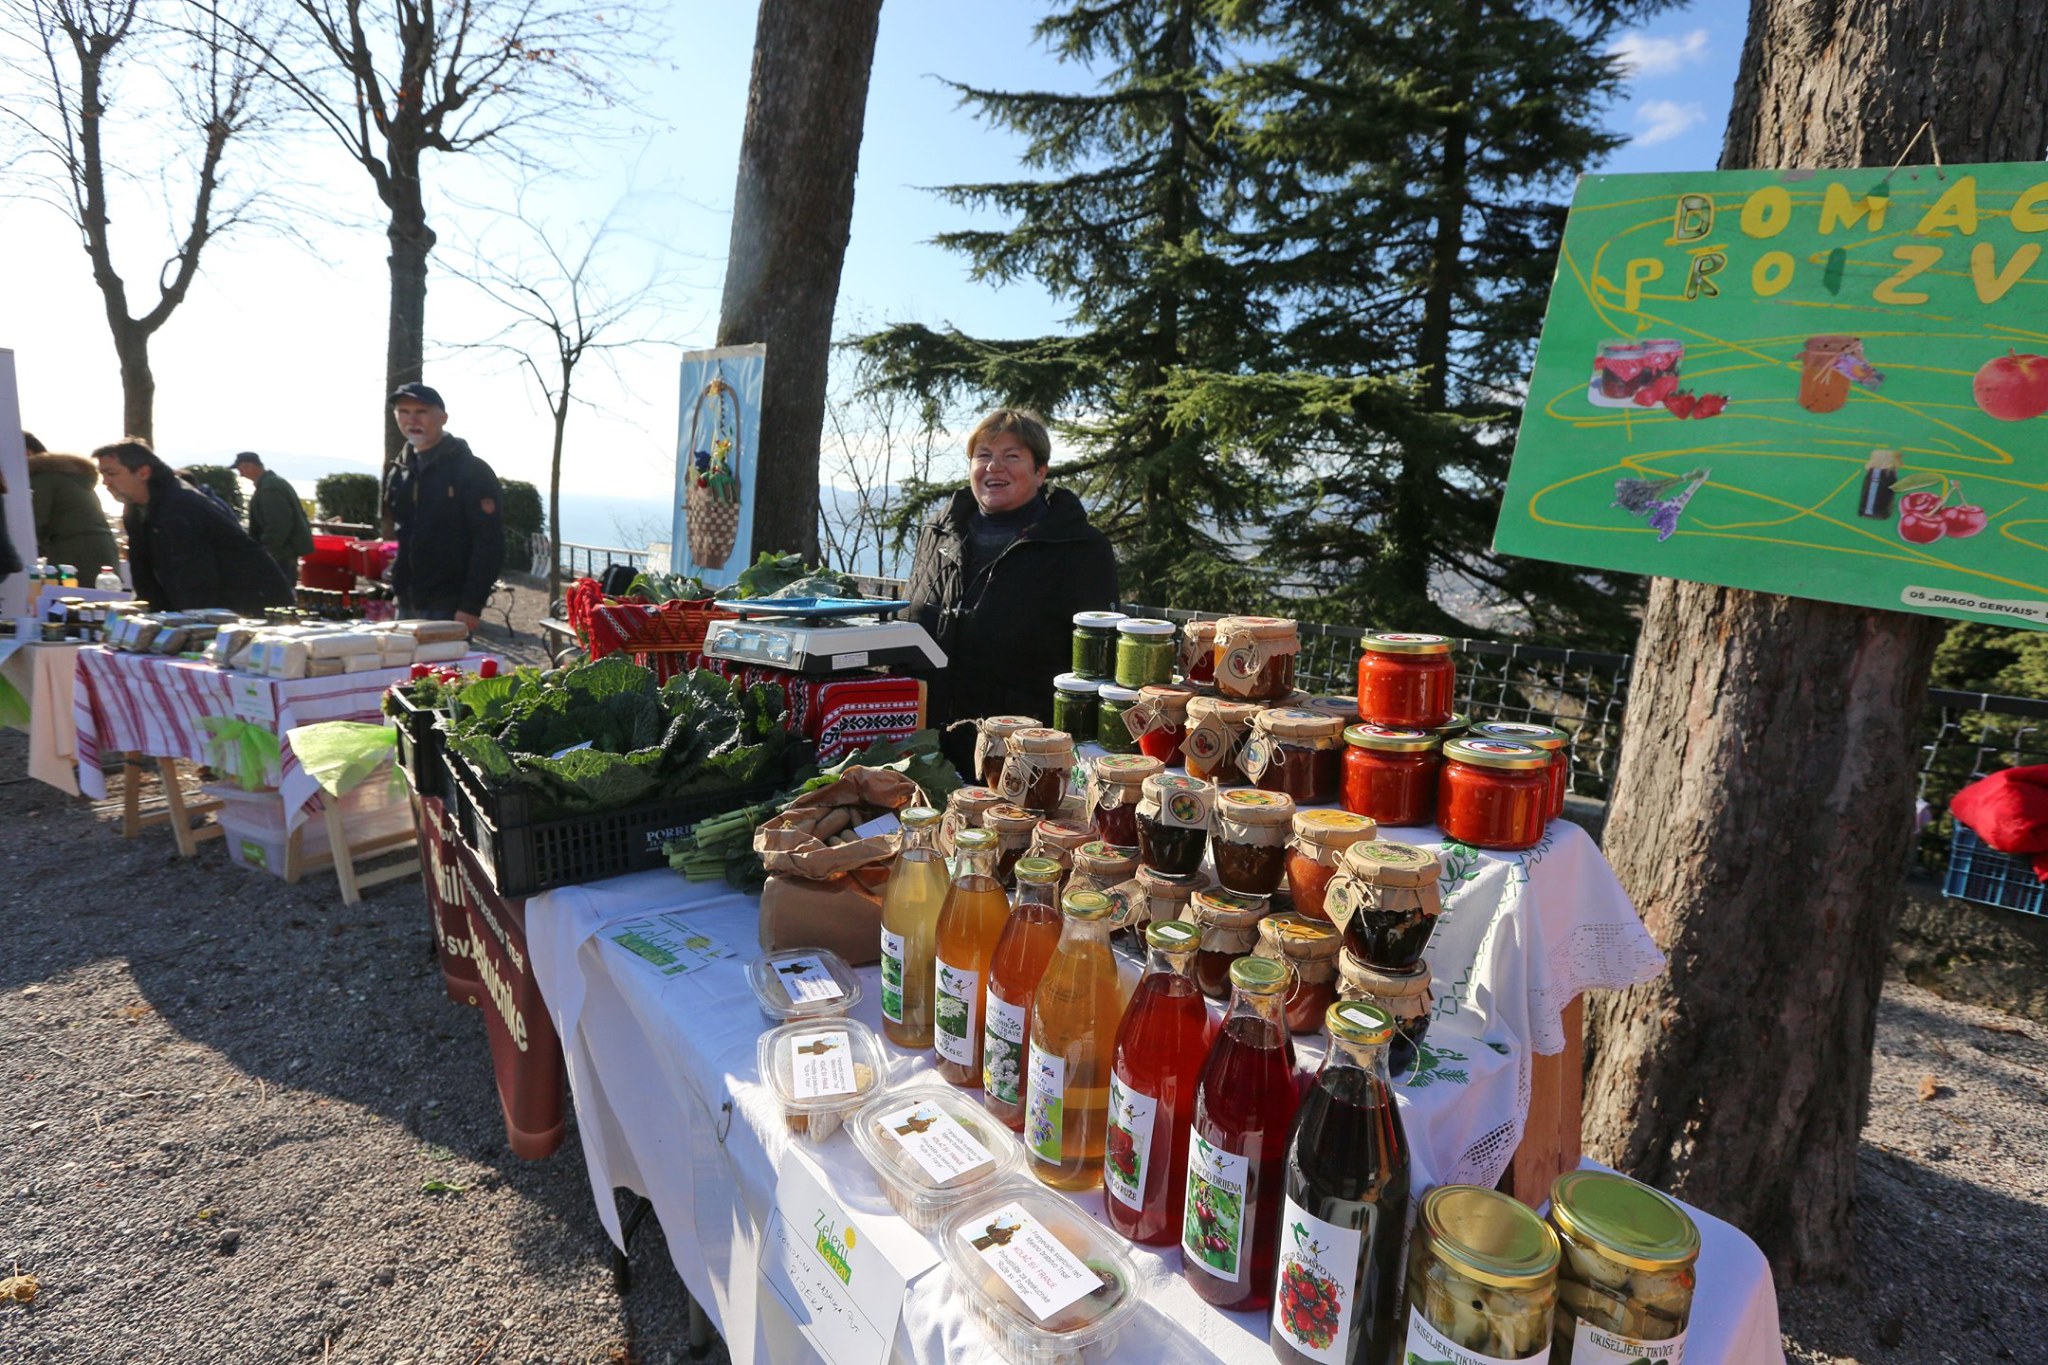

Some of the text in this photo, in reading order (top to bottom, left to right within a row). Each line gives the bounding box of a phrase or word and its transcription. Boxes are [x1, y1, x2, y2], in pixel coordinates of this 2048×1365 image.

[813, 1208, 849, 1263] Zeleni
[817, 1236, 850, 1283] Kastav
[1590, 1331, 1644, 1358] UKISELJENE
